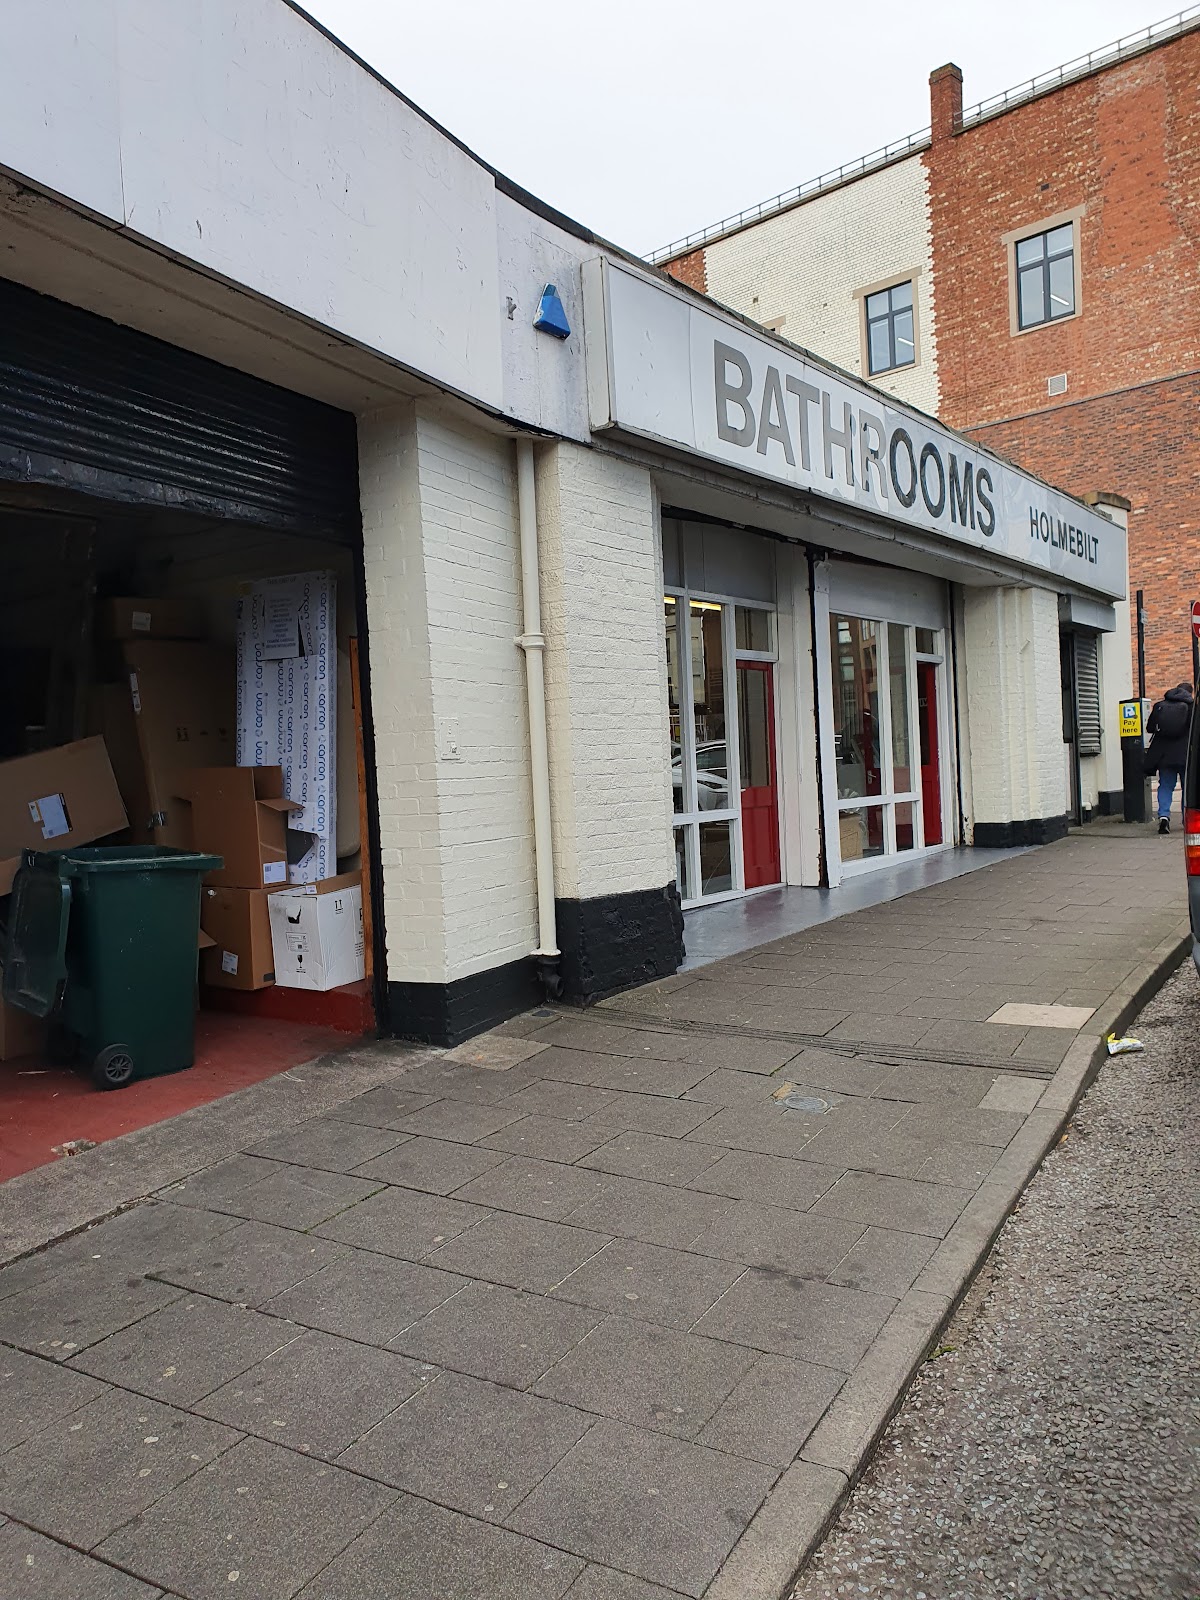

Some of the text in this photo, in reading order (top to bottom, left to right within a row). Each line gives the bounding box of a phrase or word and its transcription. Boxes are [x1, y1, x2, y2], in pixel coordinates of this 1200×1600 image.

[713, 339, 996, 538] BATHROOMS
[1029, 505, 1100, 566] HOLMEBILT
[255, 643, 263, 680] carron
[255, 692, 263, 728] carron
[318, 794, 326, 832] carron
